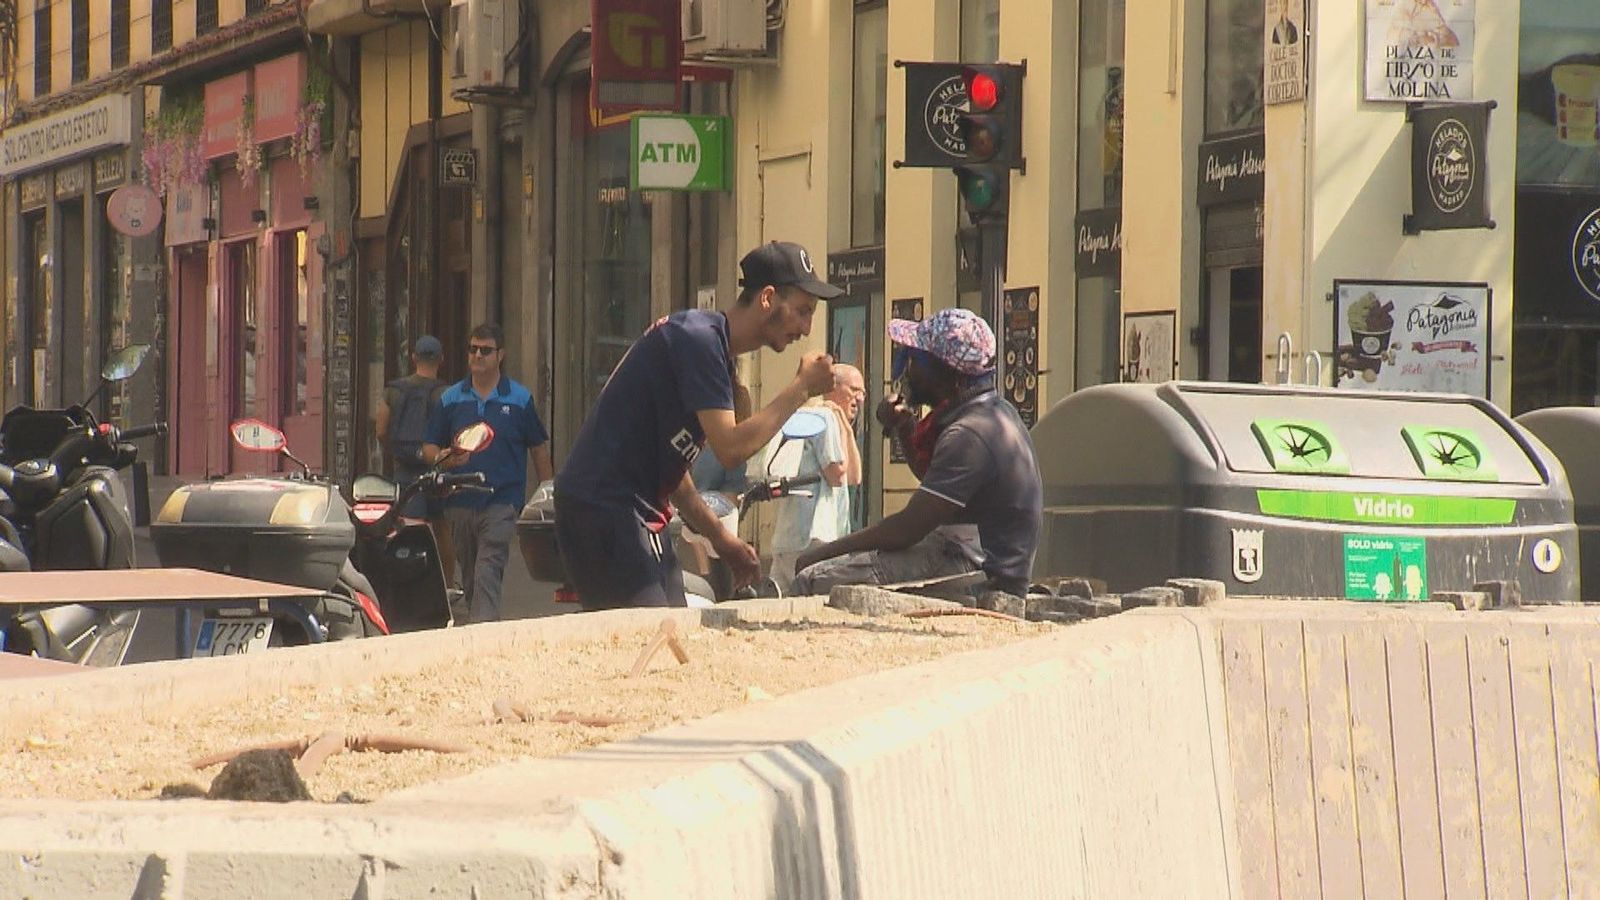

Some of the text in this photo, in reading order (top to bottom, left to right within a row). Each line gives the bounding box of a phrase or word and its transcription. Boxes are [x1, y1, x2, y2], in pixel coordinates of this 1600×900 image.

[1386, 45, 1455, 59] PLAZA DE
[1271, 61, 1298, 81] DOCTOR
[1386, 62, 1458, 79] TIRSO DE
[940, 82, 966, 100] HELA
[1268, 81, 1299, 101] CORTEZO
[1388, 81, 1450, 98] MOLINA
[641, 143, 696, 163] ATM
[1406, 308, 1477, 335] Patagonia
[1353, 496, 1415, 519] Vidrio
[1347, 539, 1371, 550] SOLO
[1372, 540, 1394, 550] vidrio
[215, 623, 267, 640] 7776
